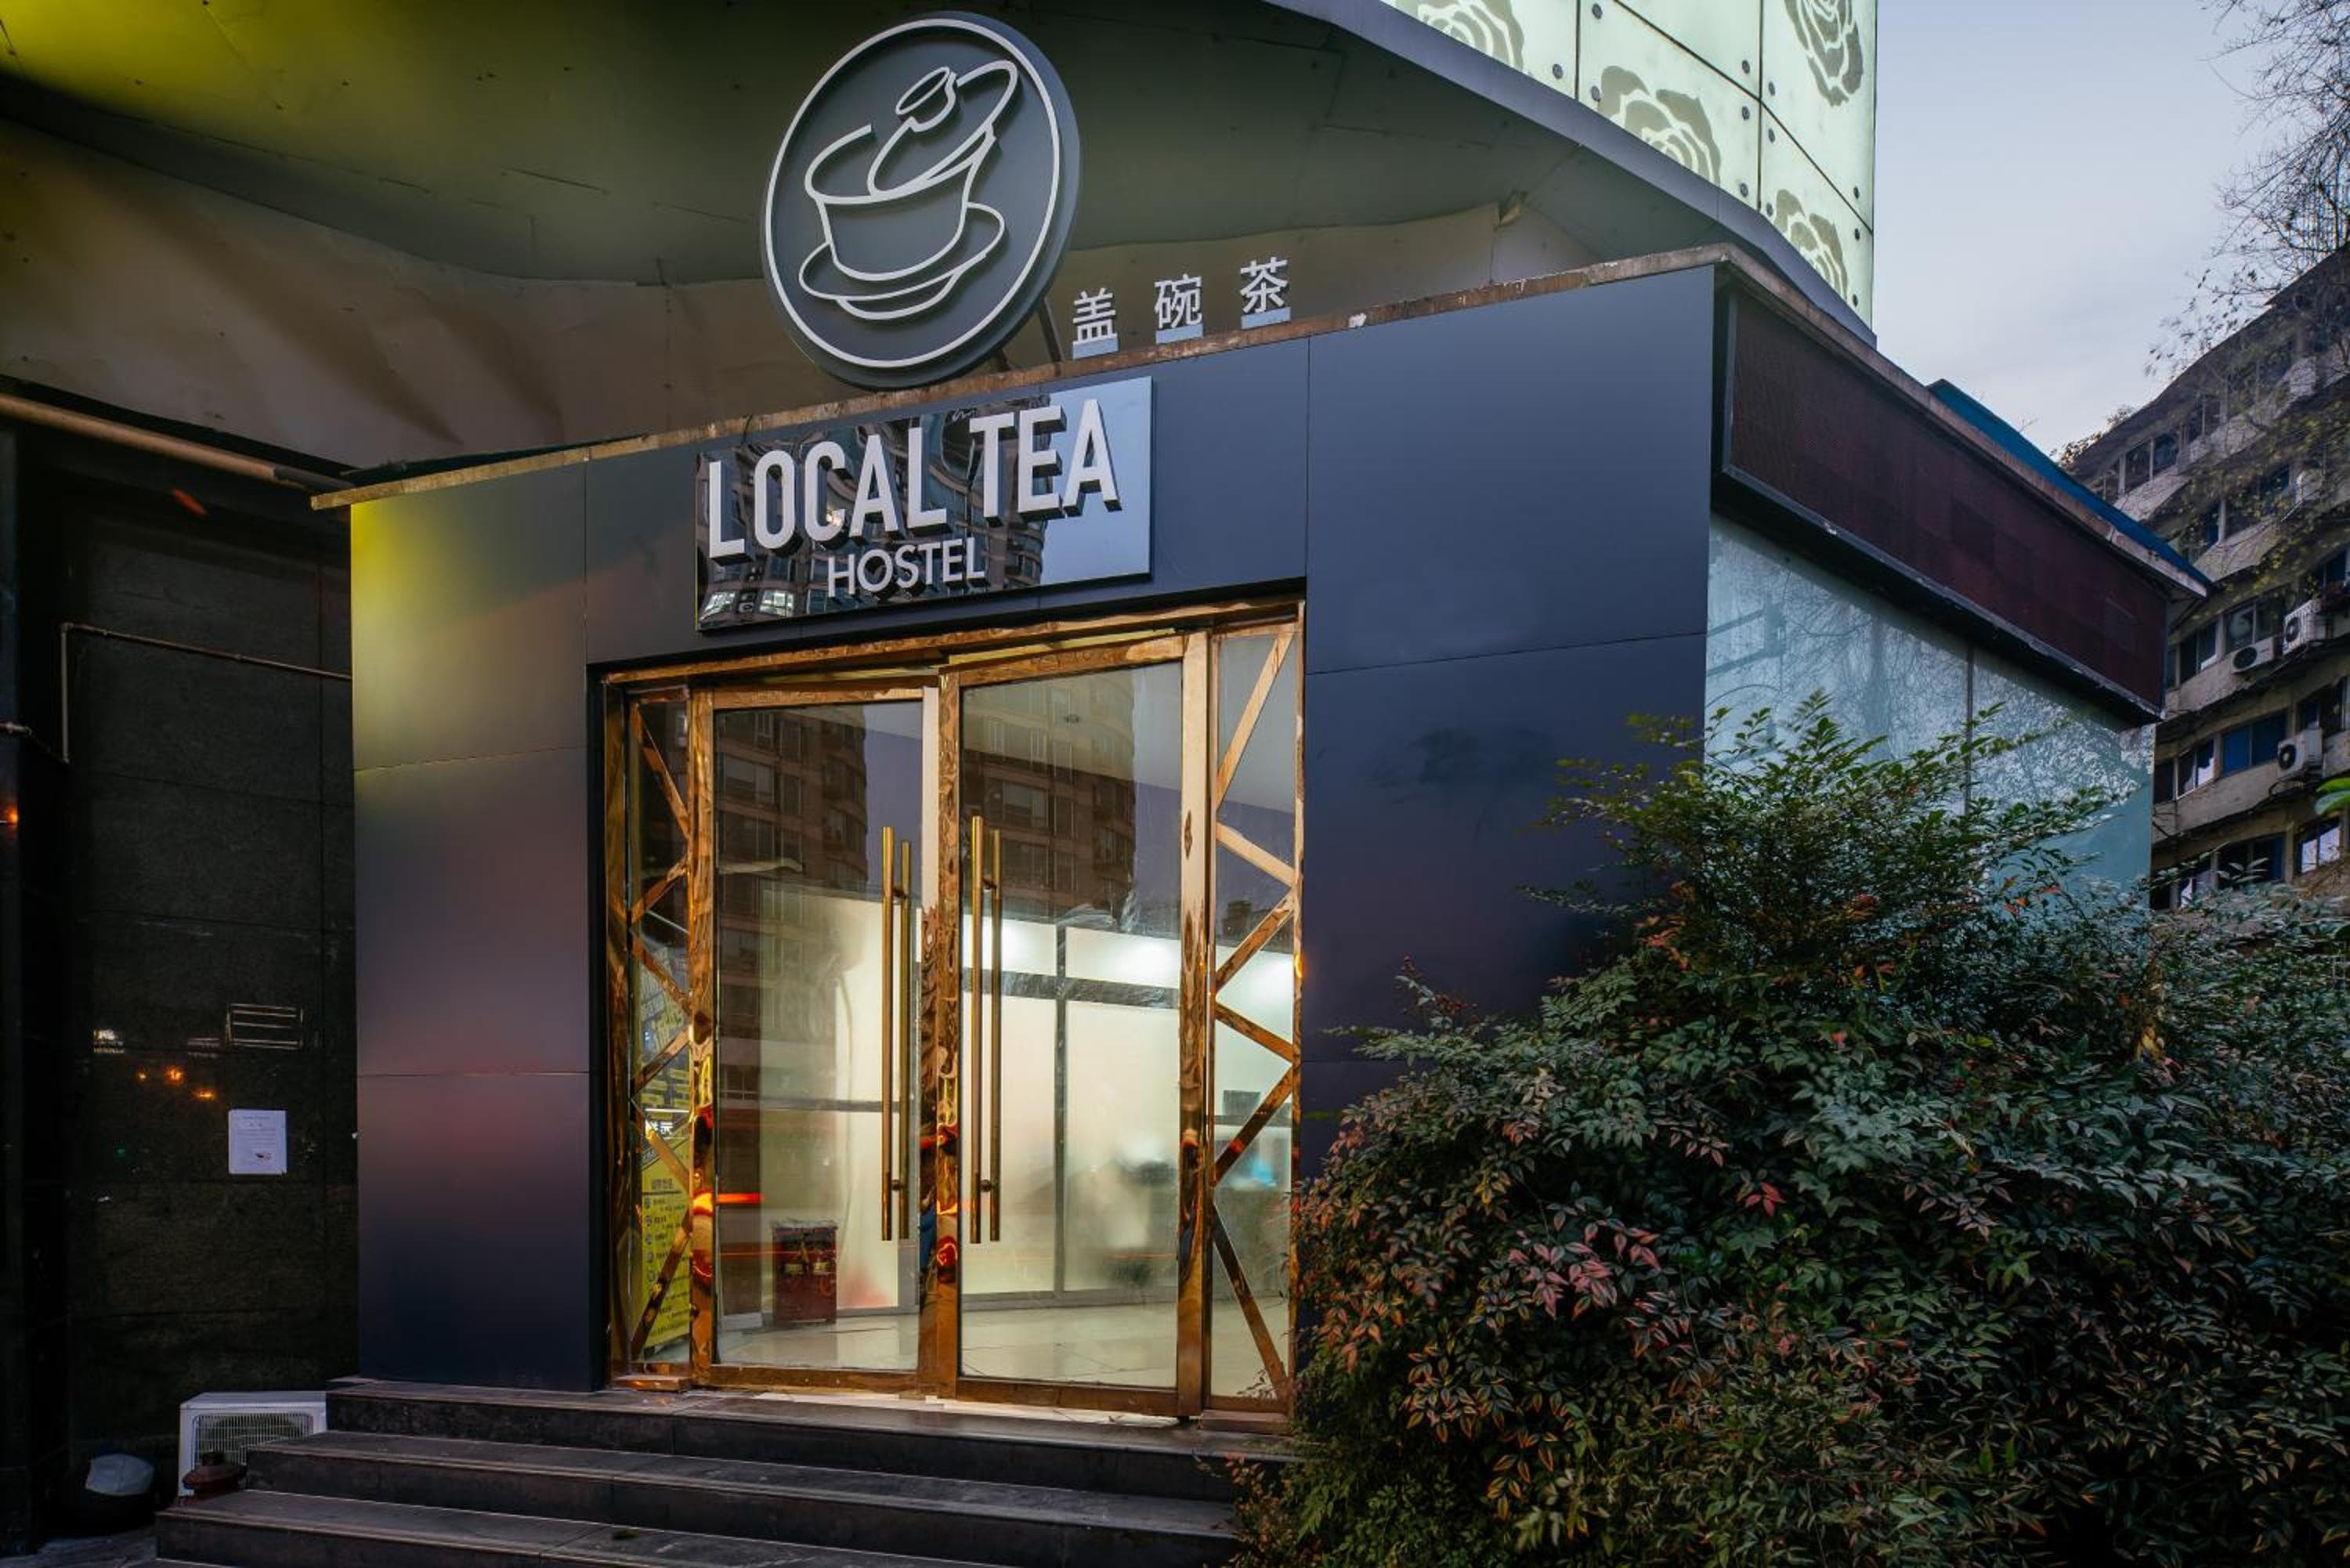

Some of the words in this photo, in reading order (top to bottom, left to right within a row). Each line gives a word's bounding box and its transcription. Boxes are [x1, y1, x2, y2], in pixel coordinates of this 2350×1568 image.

[1073, 256, 1288, 345] 盖碗茶
[709, 428, 947, 558] LOCAL
[969, 399, 1119, 520] TEA
[827, 537, 985, 598] HOSTEL
